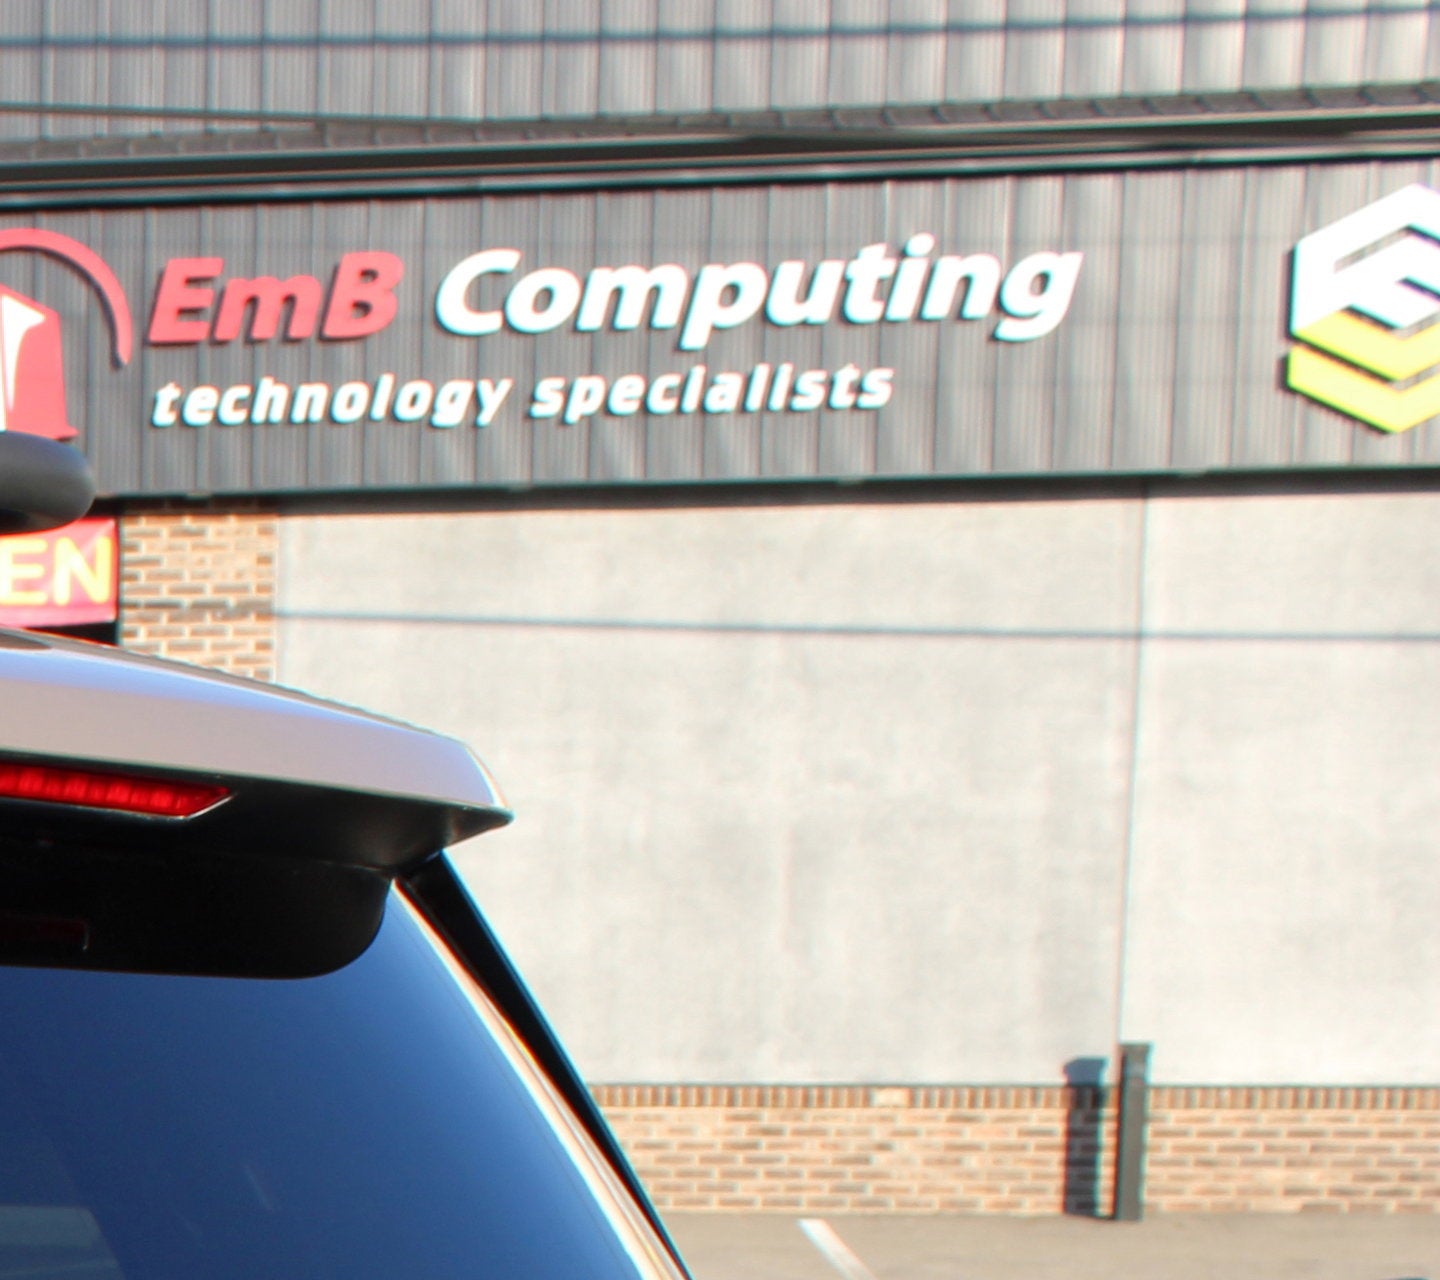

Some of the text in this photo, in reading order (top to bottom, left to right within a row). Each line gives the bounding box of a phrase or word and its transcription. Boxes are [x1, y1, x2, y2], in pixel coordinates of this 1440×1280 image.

[148, 233, 1084, 351] EmB Computing
[151, 363, 894, 428] technology specialists
